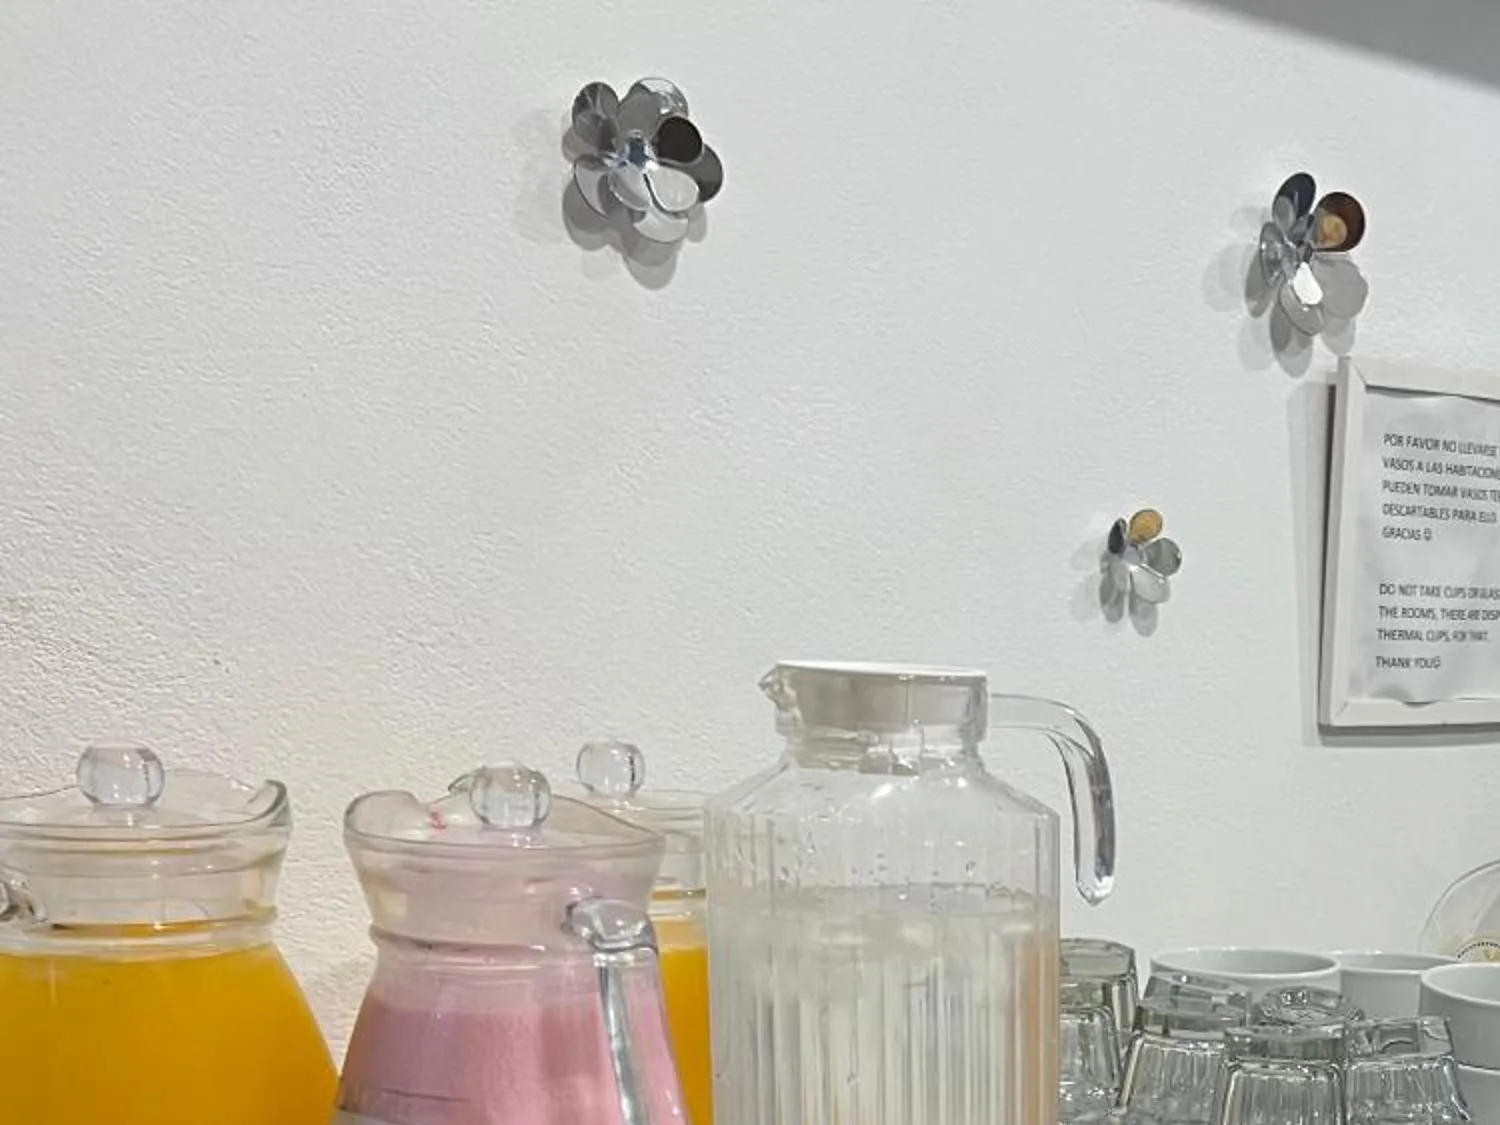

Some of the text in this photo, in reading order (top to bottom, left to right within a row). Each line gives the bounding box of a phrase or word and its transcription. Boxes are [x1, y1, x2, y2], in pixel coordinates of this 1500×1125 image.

[1384, 433, 1404, 447] POR
[1406, 436, 1440, 450] FAVOR
[1442, 440, 1457, 452] NO
[1382, 457, 1415, 471] VASOS
[1416, 461, 1424, 472] A
[1425, 461, 1443, 474] LAS
[1382, 480, 1421, 495] PUEDEN
[1423, 484, 1459, 498] TOMAR
[1382, 503, 1450, 521] DESCARTABLES
[1452, 509, 1477, 521] PARA
[1382, 526, 1422, 541] GRACIAS
[1379, 583, 1396, 596] DO
[1398, 585, 1418, 597] NOT
[1419, 585, 1442, 597] TAKE
[1443, 586, 1467, 599] CUPS
[1378, 605, 1398, 619] THE
[1376, 628, 1424, 642] THERMAL
[1375, 655, 1411, 669] THANK
